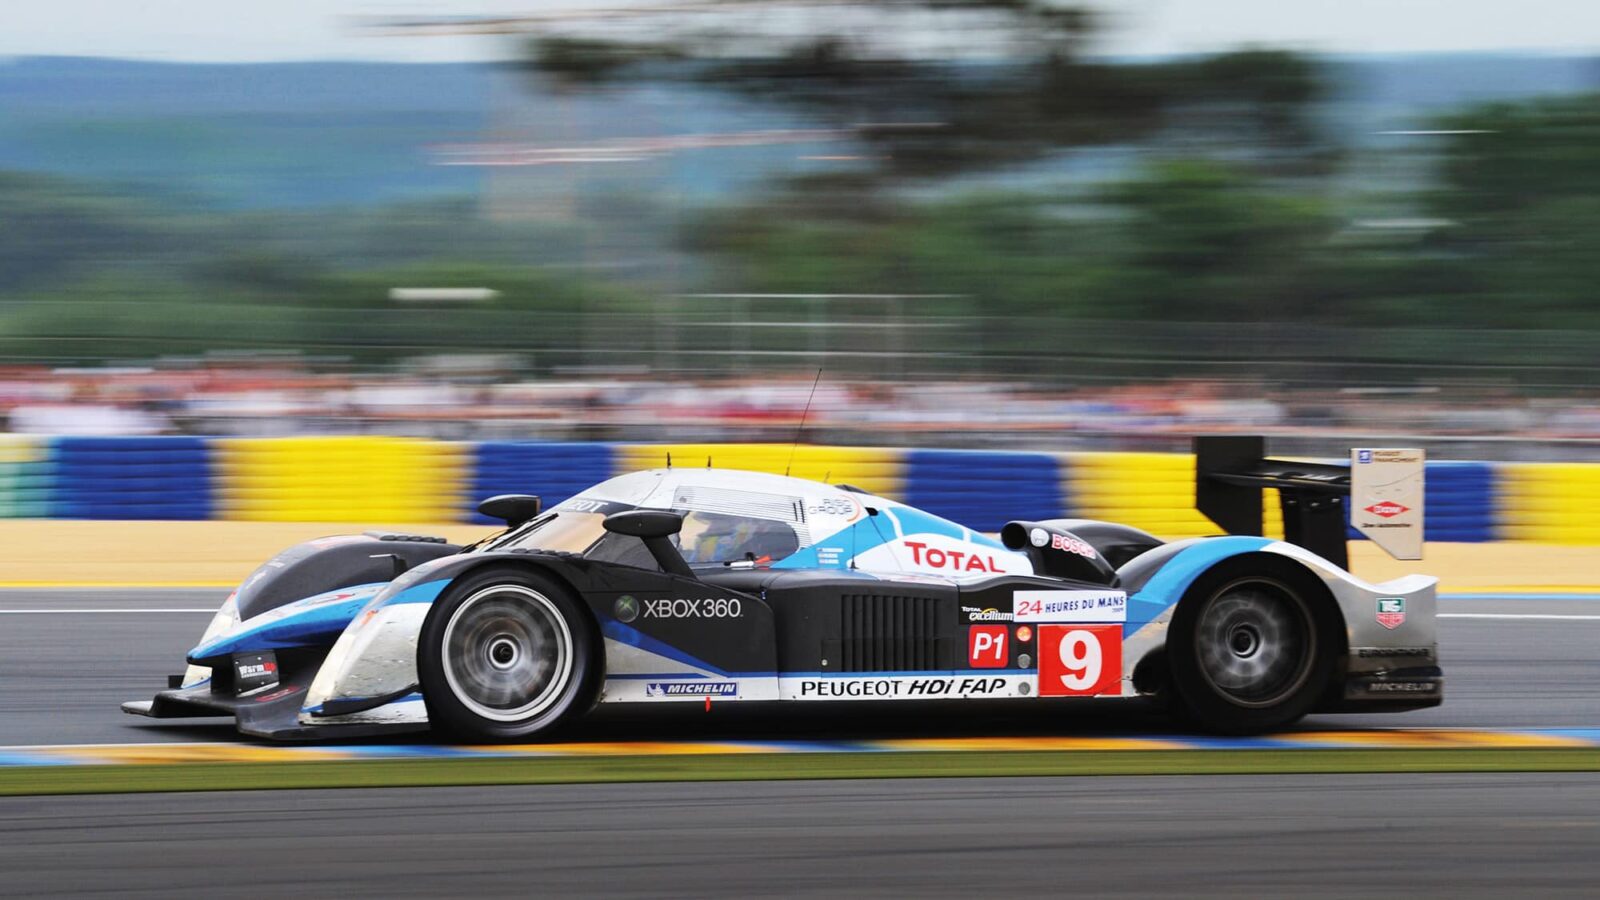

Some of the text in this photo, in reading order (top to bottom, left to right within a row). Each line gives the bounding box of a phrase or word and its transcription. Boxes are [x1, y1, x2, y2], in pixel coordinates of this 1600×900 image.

[1051, 533, 1097, 560] BOSCH
[904, 541, 1006, 574] TOTAL
[643, 599, 741, 618] XBOX 360
[969, 610, 1014, 621] excellium
[1016, 596, 1124, 616] 24 HEURES DU MANS
[972, 632, 1005, 660] P1
[1059, 629, 1103, 691] 9
[667, 683, 736, 694] MICHELIN
[801, 680, 902, 696] PEUGEOT
[957, 678, 1006, 694] FAP
